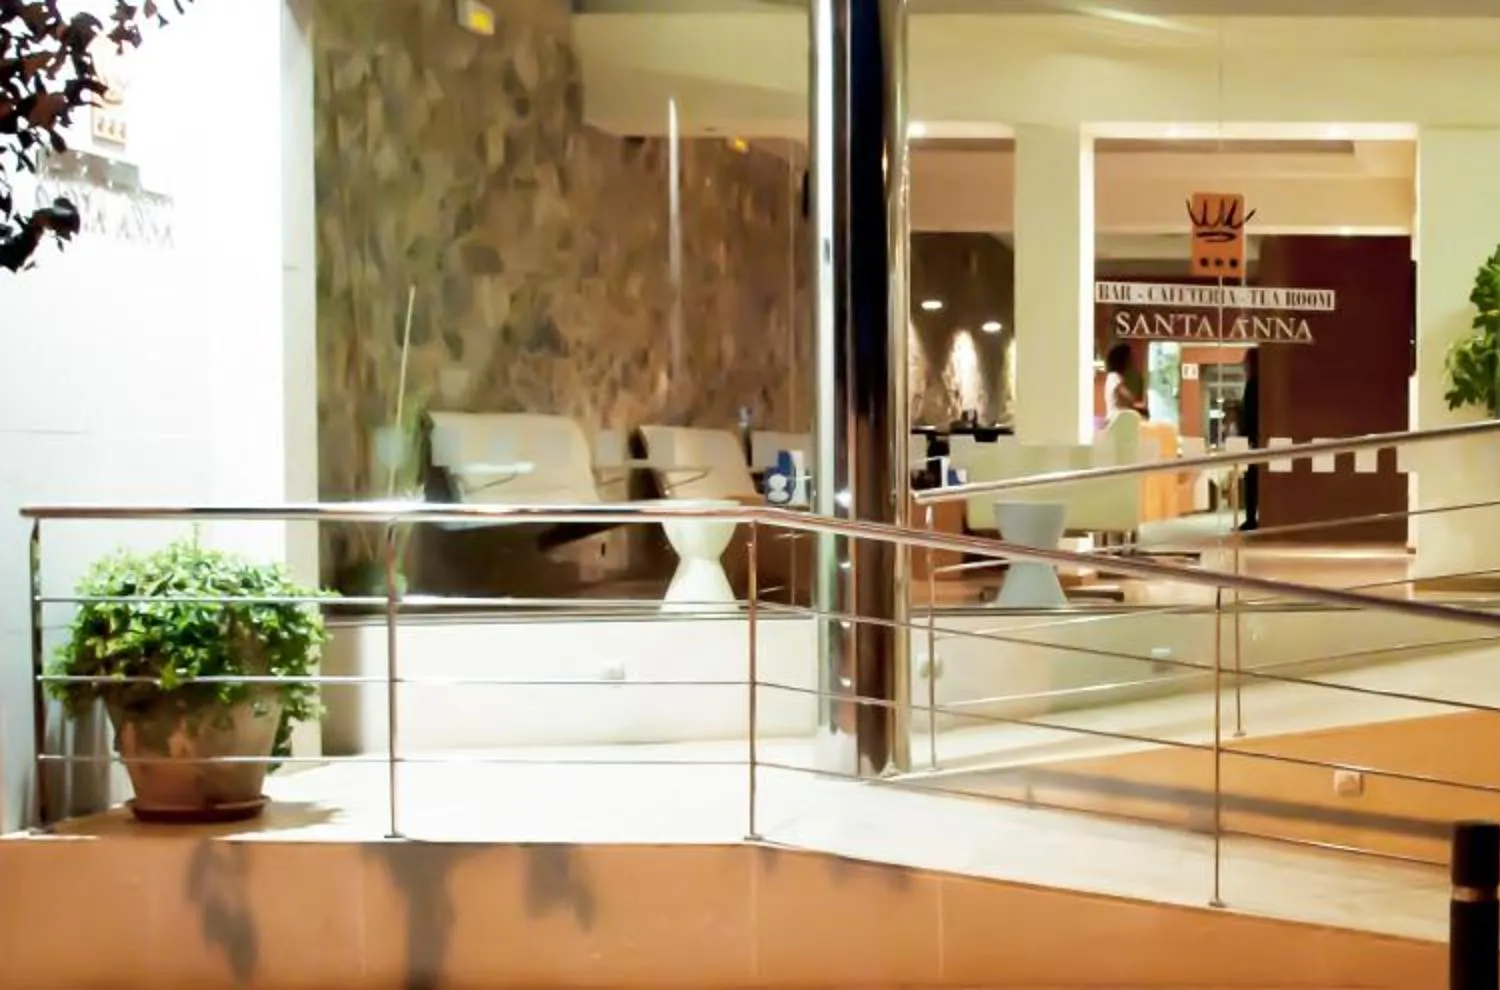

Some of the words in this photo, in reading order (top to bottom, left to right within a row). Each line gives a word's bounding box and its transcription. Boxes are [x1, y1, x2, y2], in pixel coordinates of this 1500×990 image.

[1099, 283, 1132, 301] BAR
[1147, 286, 1236, 306] CAFETERIA
[1250, 290, 1280, 307] TEA
[1286, 291, 1332, 308] ROOM
[1115, 311, 1215, 338] SANTA
[1228, 316, 1313, 341] ANNA
